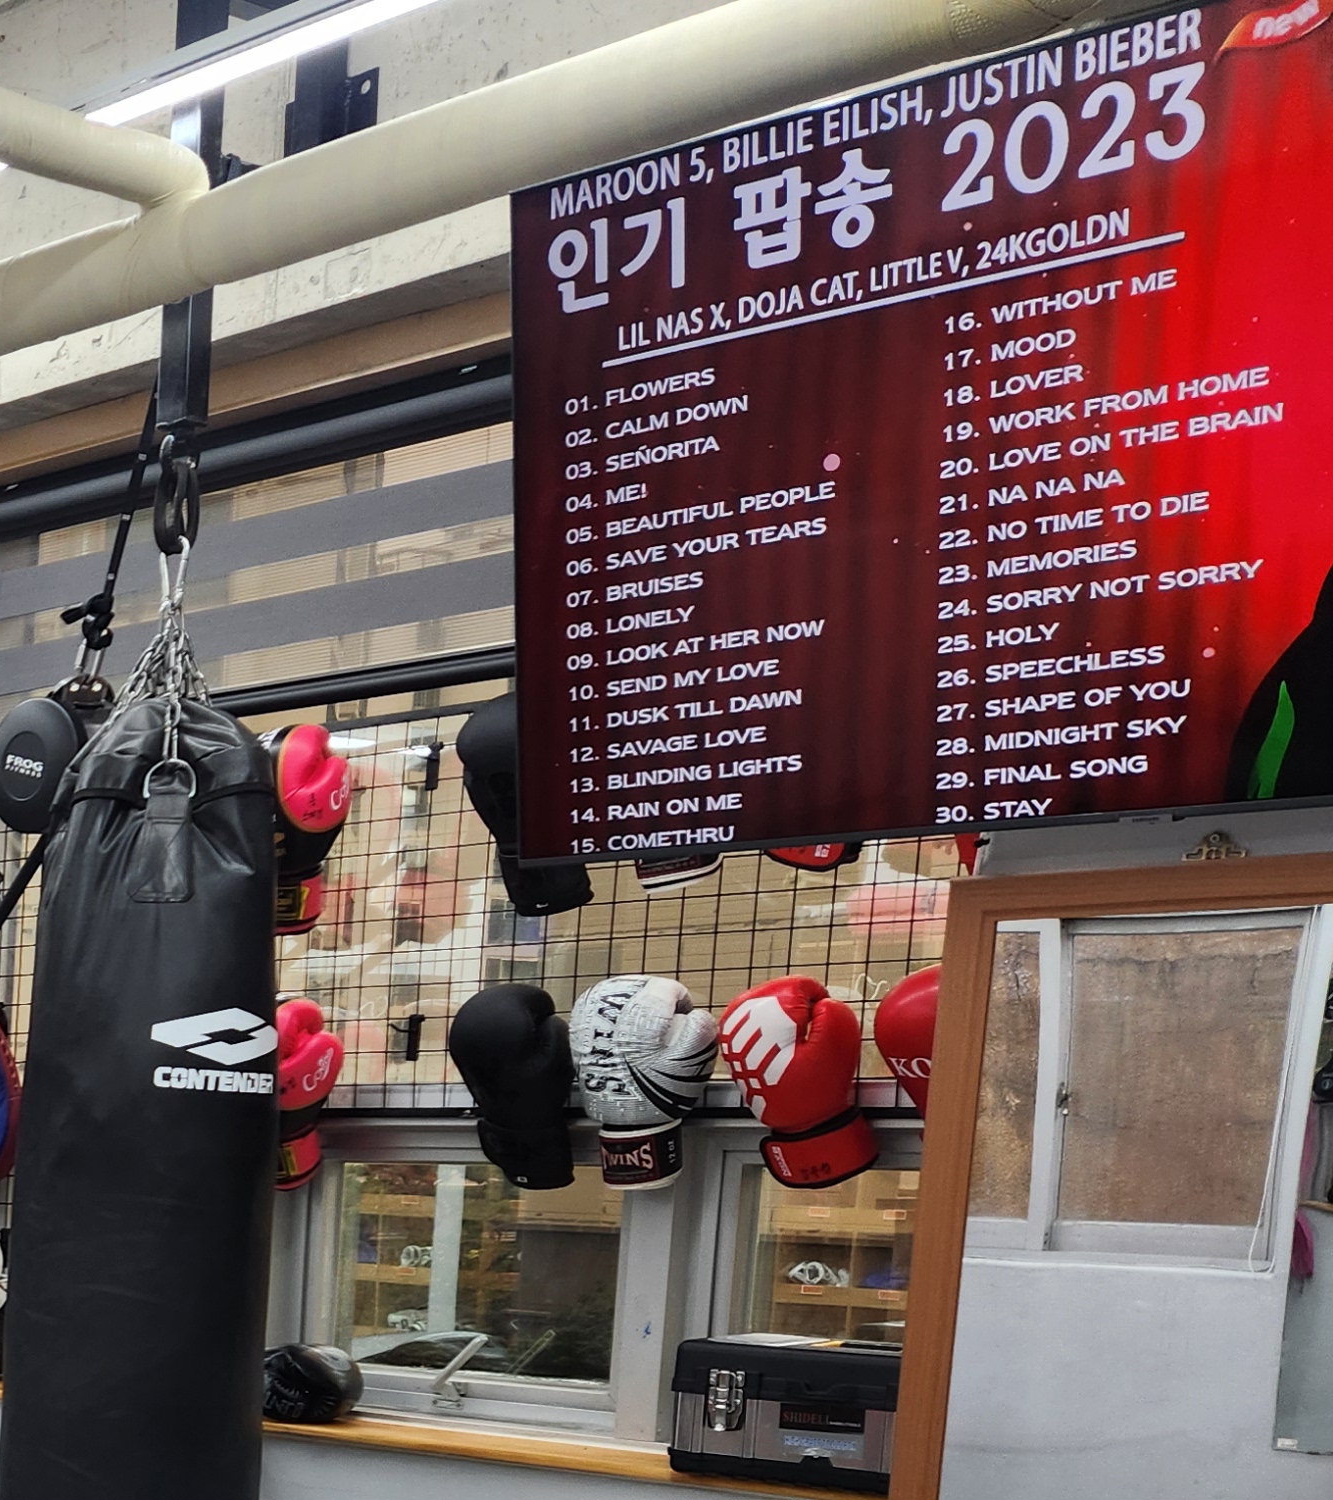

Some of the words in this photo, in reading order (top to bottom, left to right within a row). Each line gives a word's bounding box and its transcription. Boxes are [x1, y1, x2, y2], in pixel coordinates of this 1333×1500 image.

[549, 156, 682, 220] MAROON
[689, 146, 714, 184] 5,
[722, 117, 816, 175] BILLIE
[823, 87, 933, 148] EILISH,
[940, 47, 1064, 119] JUSTIN
[1074, 9, 1203, 83] BIEBER
[548, 196, 686, 313] 인기
[733, 147, 893, 269] 팝송
[941, 61, 1206, 212] 2023
[618, 321, 651, 351] LIL
[656, 307, 704, 342] NAS
[709, 302, 732, 331] X,
[738, 284, 804, 324] DOJA
[810, 270, 863, 306] CAT,
[975, 207, 1129, 270] 24KGOLDN
[945, 312, 982, 334] 16.
[990, 280, 1123, 324] WITHOUT
[1130, 268, 1177, 296] ME
[944, 348, 981, 371] 17.
[991, 328, 1077, 362] MOOD
[565, 395, 598, 415] 01.
[605, 367, 715, 407] FLOWERS
[942, 421, 980, 443] 19.
[988, 402, 1077, 434] WORK
[1083, 384, 1168, 418] FROM
[1177, 366, 1270, 401] HOME
[943, 385, 981, 407] 18.
[990, 364, 1084, 399] LOVER
[565, 428, 598, 448] 02.
[605, 411, 669, 439] CALM
[676, 394, 748, 426] DOWN
[939, 457, 979, 479] 20.
[989, 441, 1062, 471] LOVE
[1069, 432, 1111, 457] ON
[1119, 421, 1180, 448] THE
[1188, 402, 1284, 437] BRAIN
[565, 461, 598, 480] 03.
[605, 435, 721, 473] SEÑORITA
[566, 493, 598, 513] 04.
[605, 483, 647, 506] ME!
[566, 526, 598, 545] 05.
[606, 500, 734, 538] BEAUTIFUL
[739, 480, 836, 514] PEOPLE
[939, 493, 979, 515] 21.
[988, 484, 1029, 507] NA
[1035, 477, 1077, 499] NA
[1083, 468, 1126, 492] NA
[939, 528, 979, 550] 22.
[987, 520, 1028, 542] NO
[1034, 508, 1104, 534] TIME
[1111, 501, 1152, 523] TO
[1160, 491, 1210, 517] DIE
[566, 557, 598, 577] 06.
[606, 544, 667, 570] SAVE
[672, 532, 740, 558] YOUR
[745, 517, 827, 546] TEARS
[938, 564, 978, 585] 23.
[987, 539, 1137, 578] MEMORIES
[566, 589, 599, 608] 07.
[606, 571, 704, 602] BRUISES
[938, 598, 977, 620] 24.
[986, 583, 1083, 613] SORRY
[1089, 574, 1151, 599] NOT
[1158, 558, 1264, 591] SORRY
[566, 621, 599, 639] 08.
[606, 605, 695, 634] LONELY
[937, 633, 977, 654] 25.
[985, 622, 1060, 648] HOLY
[566, 653, 599, 671] 09.
[606, 641, 669, 666] LOOK
[672, 636, 705, 656] AT
[709, 629, 760, 651] HER
[766, 619, 825, 643] NOW
[936, 668, 976, 689] 26.
[985, 645, 1165, 683] SPEECHLESS
[569, 684, 599, 701] 10.
[606, 674, 667, 697] SEND
[673, 668, 711, 688] MY
[716, 659, 780, 683] LOVE
[936, 702, 975, 723] 27.
[984, 691, 1076, 718] SHAPE
[1084, 686, 1123, 707] OF
[1129, 678, 1191, 701] YOU
[570, 716, 600, 733] 11.
[607, 706, 669, 729] DUSK
[673, 699, 725, 719] TILL
[729, 688, 802, 713] DAWN
[570, 746, 600, 763] 12.
[607, 734, 698, 759] SAVAGE
[704, 726, 767, 748] LOVE
[936, 737, 975, 756] 28.
[984, 722, 1119, 752] MIDNIGHT
[1126, 715, 1187, 738] SKY
[5, 753, 44, 772] FROG
[570, 777, 600, 793] 13.
[607, 764, 712, 790] BLINDING
[718, 754, 803, 779] LIGHTS
[936, 771, 975, 790] 29.
[984, 763, 1062, 786] FINAL
[1069, 754, 1148, 779] SONG
[570, 807, 600, 824] 14.
[607, 801, 660, 821] RAIN
[666, 797, 699, 815] ON
[706, 793, 743, 811] ME
[935, 805, 974, 824] 30.
[983, 798, 1053, 820] STAY
[571, 837, 600, 854] 15.
[608, 825, 735, 851] COMETHRU
[153, 1065, 275, 1095] CONTENDER
[600, 1142, 654, 1171] TWINS
